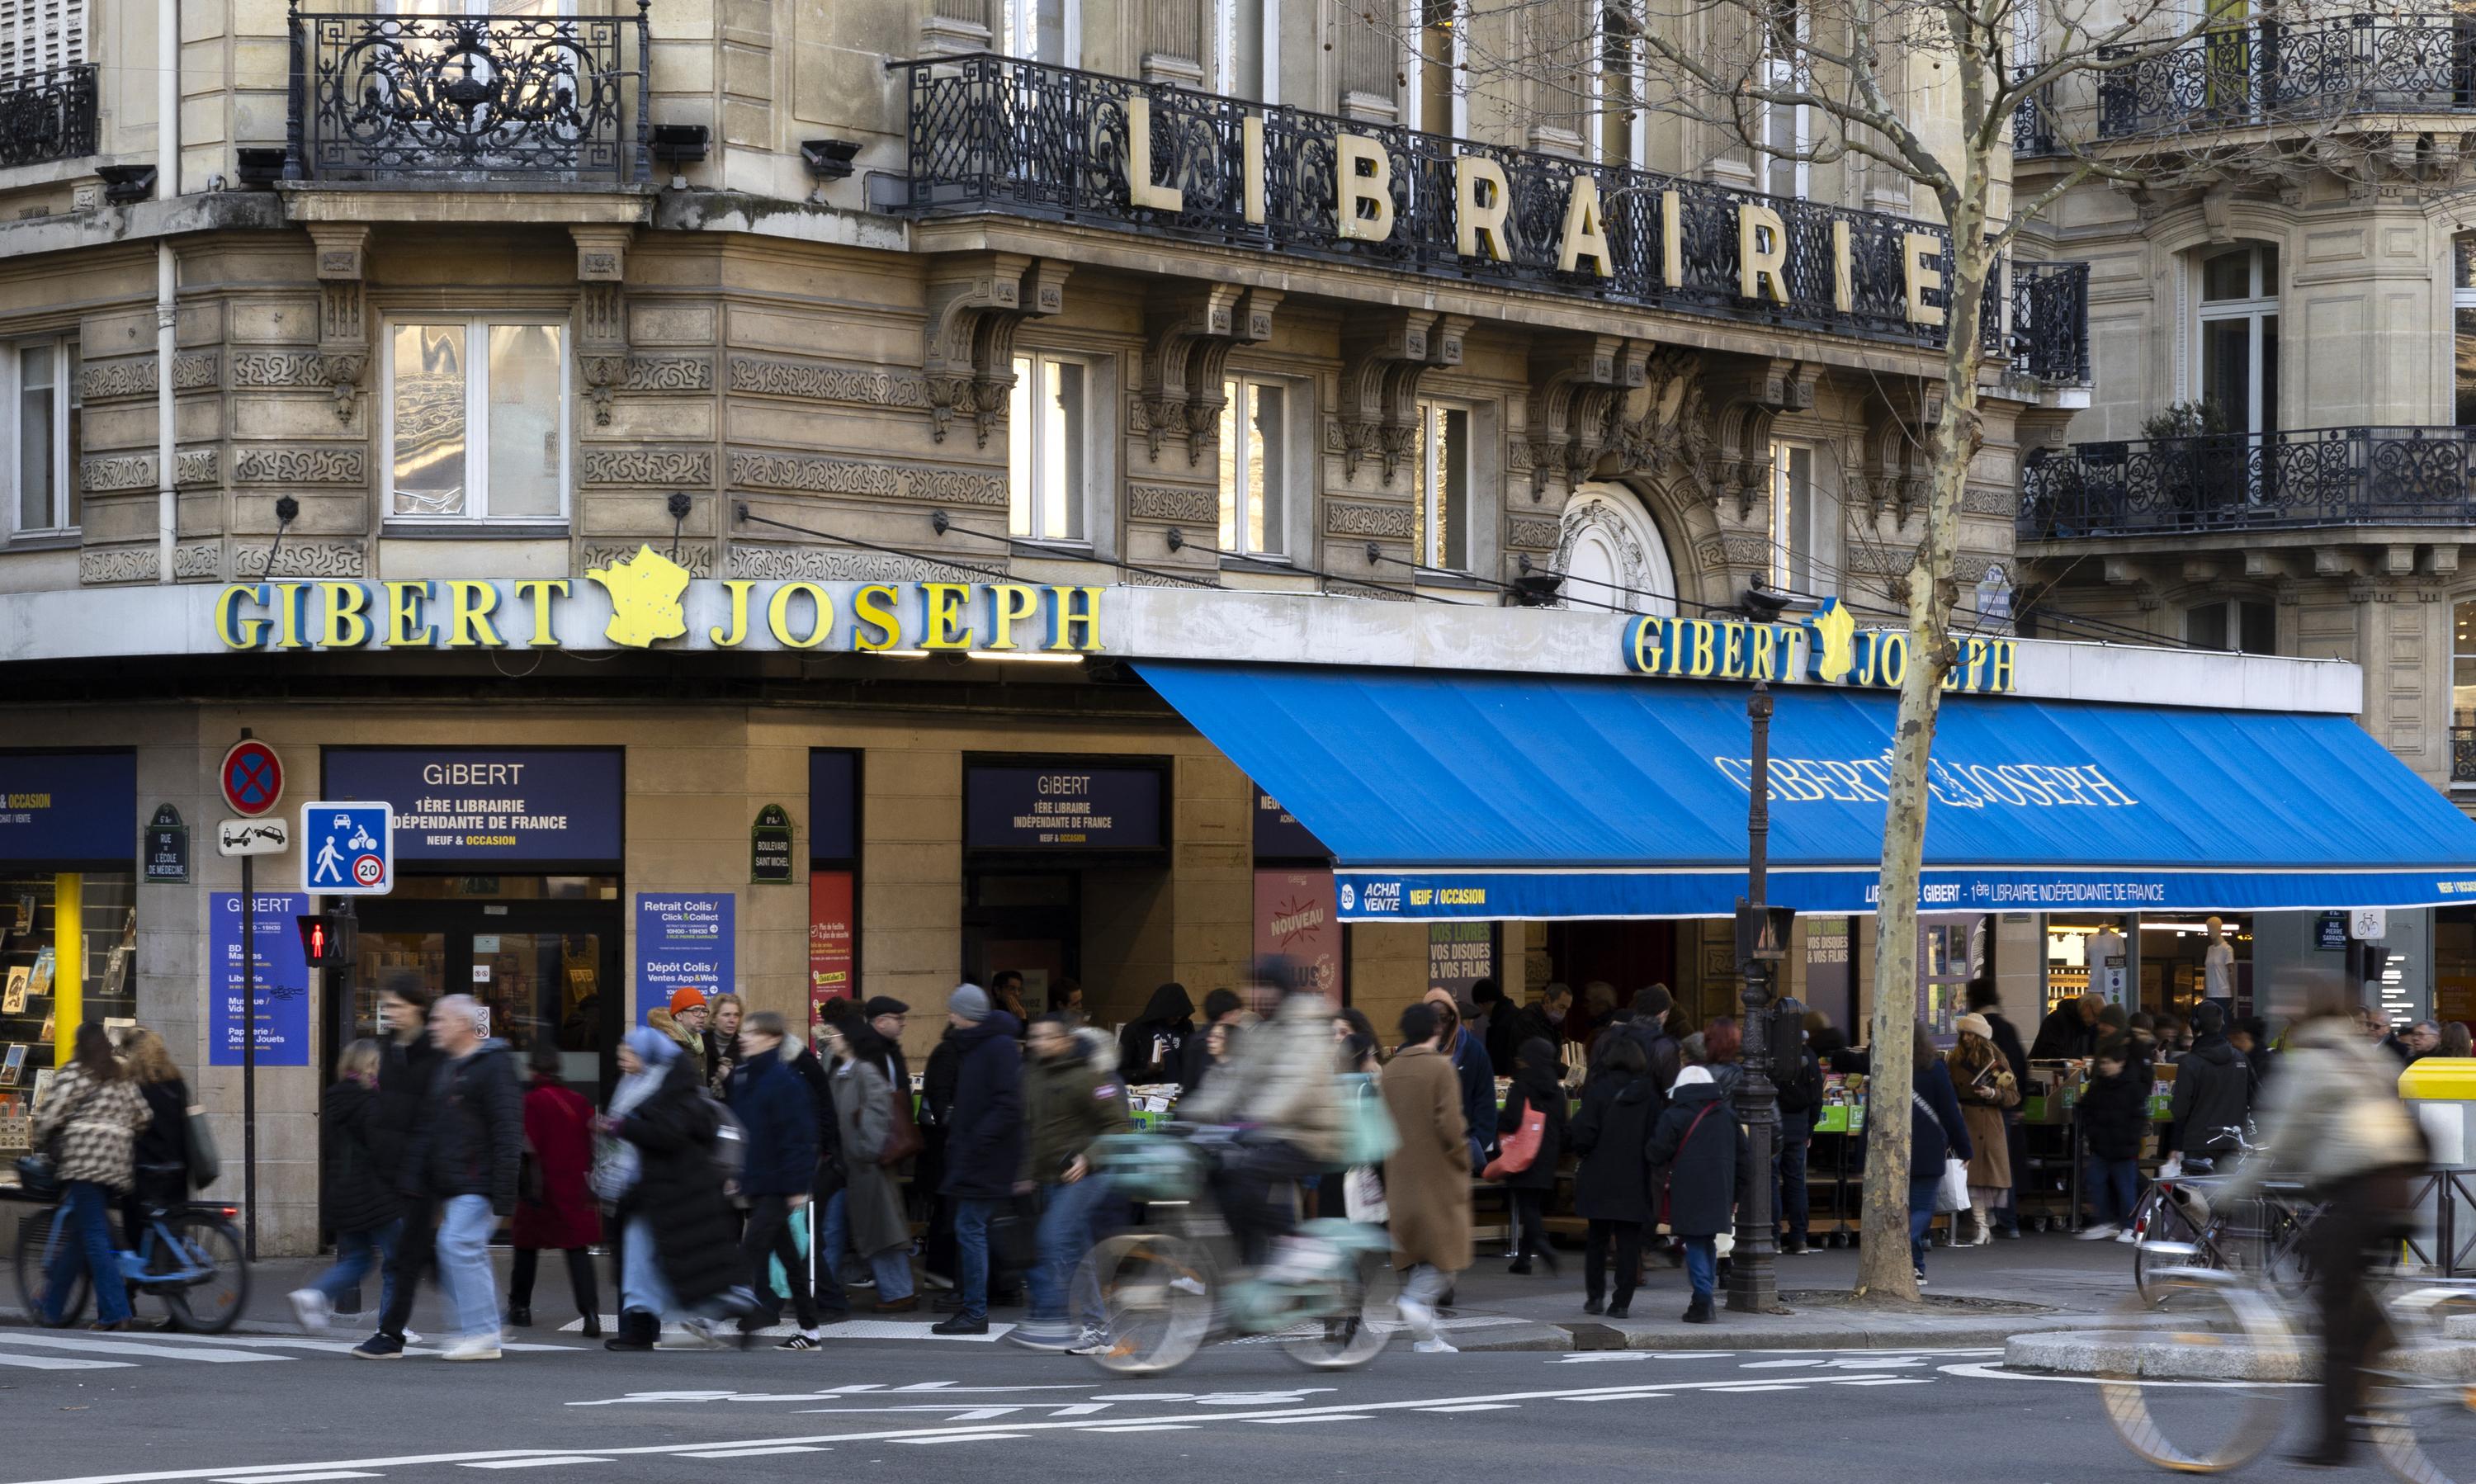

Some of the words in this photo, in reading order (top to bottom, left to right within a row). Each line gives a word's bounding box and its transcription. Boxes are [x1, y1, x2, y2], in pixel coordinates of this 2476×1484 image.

[1128, 96, 1945, 327] LIBRAIRIE
[213, 579, 574, 650] GIBERT
[709, 579, 1107, 652] JOSEPH
[1628, 615, 1804, 683] GIBERT
[1949, 762, 2139, 806] JOSEPH
[8, 793, 51, 809] OCCASION
[415, 796, 451, 813] 1ÈRE
[456, 799, 525, 813] LIBRAIRIE
[1033, 800, 1052, 814] 1ÈRE
[1055, 802, 1091, 814] LIBRAIRIE
[16, 814, 31, 823] VENTE
[393, 813, 484, 829] DÉPENDANTE
[489, 815, 507, 829] DE
[512, 815, 567, 829] FRANCE
[1014, 814, 1070, 829] INDÉPENDANTE
[1072, 816, 1081, 828] DE
[1084, 816, 1112, 829] FRANCE
[160, 834, 171, 844] RUE
[427, 836, 452, 846] NEUF
[456, 836, 463, 846] &
[466, 836, 516, 846] OCCASION
[1040, 834, 1053, 843] NEUF
[1055, 834, 1059, 843] &
[1060, 834, 1086, 843] OCCASION
[758, 841, 787, 851] BOULEVARD
[755, 857, 770, 867] SAINT
[771, 857, 788, 867] MICHEL
[149, 865, 156, 874] DE
[360, 865, 377, 876] 20
[1364, 883, 1401, 897] ACHAT
[1410, 890, 1433, 905] NEUF
[1440, 889, 1486, 905] OCCASION
[1923, 884, 1961, 902] GIBERT
[1992, 884, 2039, 901] LIBRAIRIE
[2039, 880, 2112, 901] INDÉPENDANTE
[2114, 884, 2126, 900] DE
[2128, 884, 2164, 900] FRANCE
[1343, 891, 1352, 904] 26
[1364, 898, 1401, 911] VENTE
[645, 901, 681, 911] Retrait
[684, 901, 711, 911] Colis
[1271, 908, 1324, 936] NOUVEAU
[1807, 920, 1822, 935] VOS
[1824, 919, 1848, 935] LIVRES
[1432, 924, 1451, 942] VOS
[1454, 923, 1491, 942] LIVRES
[1807, 936, 1820, 949] VOS
[1822, 935, 1848, 949] DISQUES
[1431, 944, 1449, 960] VOS
[1452, 943, 1491, 962] DISQUES
[1807, 951, 1812, 963] &
[1813, 951, 1826, 962] VOS
[1828, 949, 1848, 962] FILMS
[647, 962, 680, 973] Dépôt
[683, 962, 711, 971] Colis
[1321, 964, 1330, 977] &
[1430, 962, 1439, 978] &
[1441, 962, 1458, 978] VOS
[1462, 960, 1491, 977] FILMS
